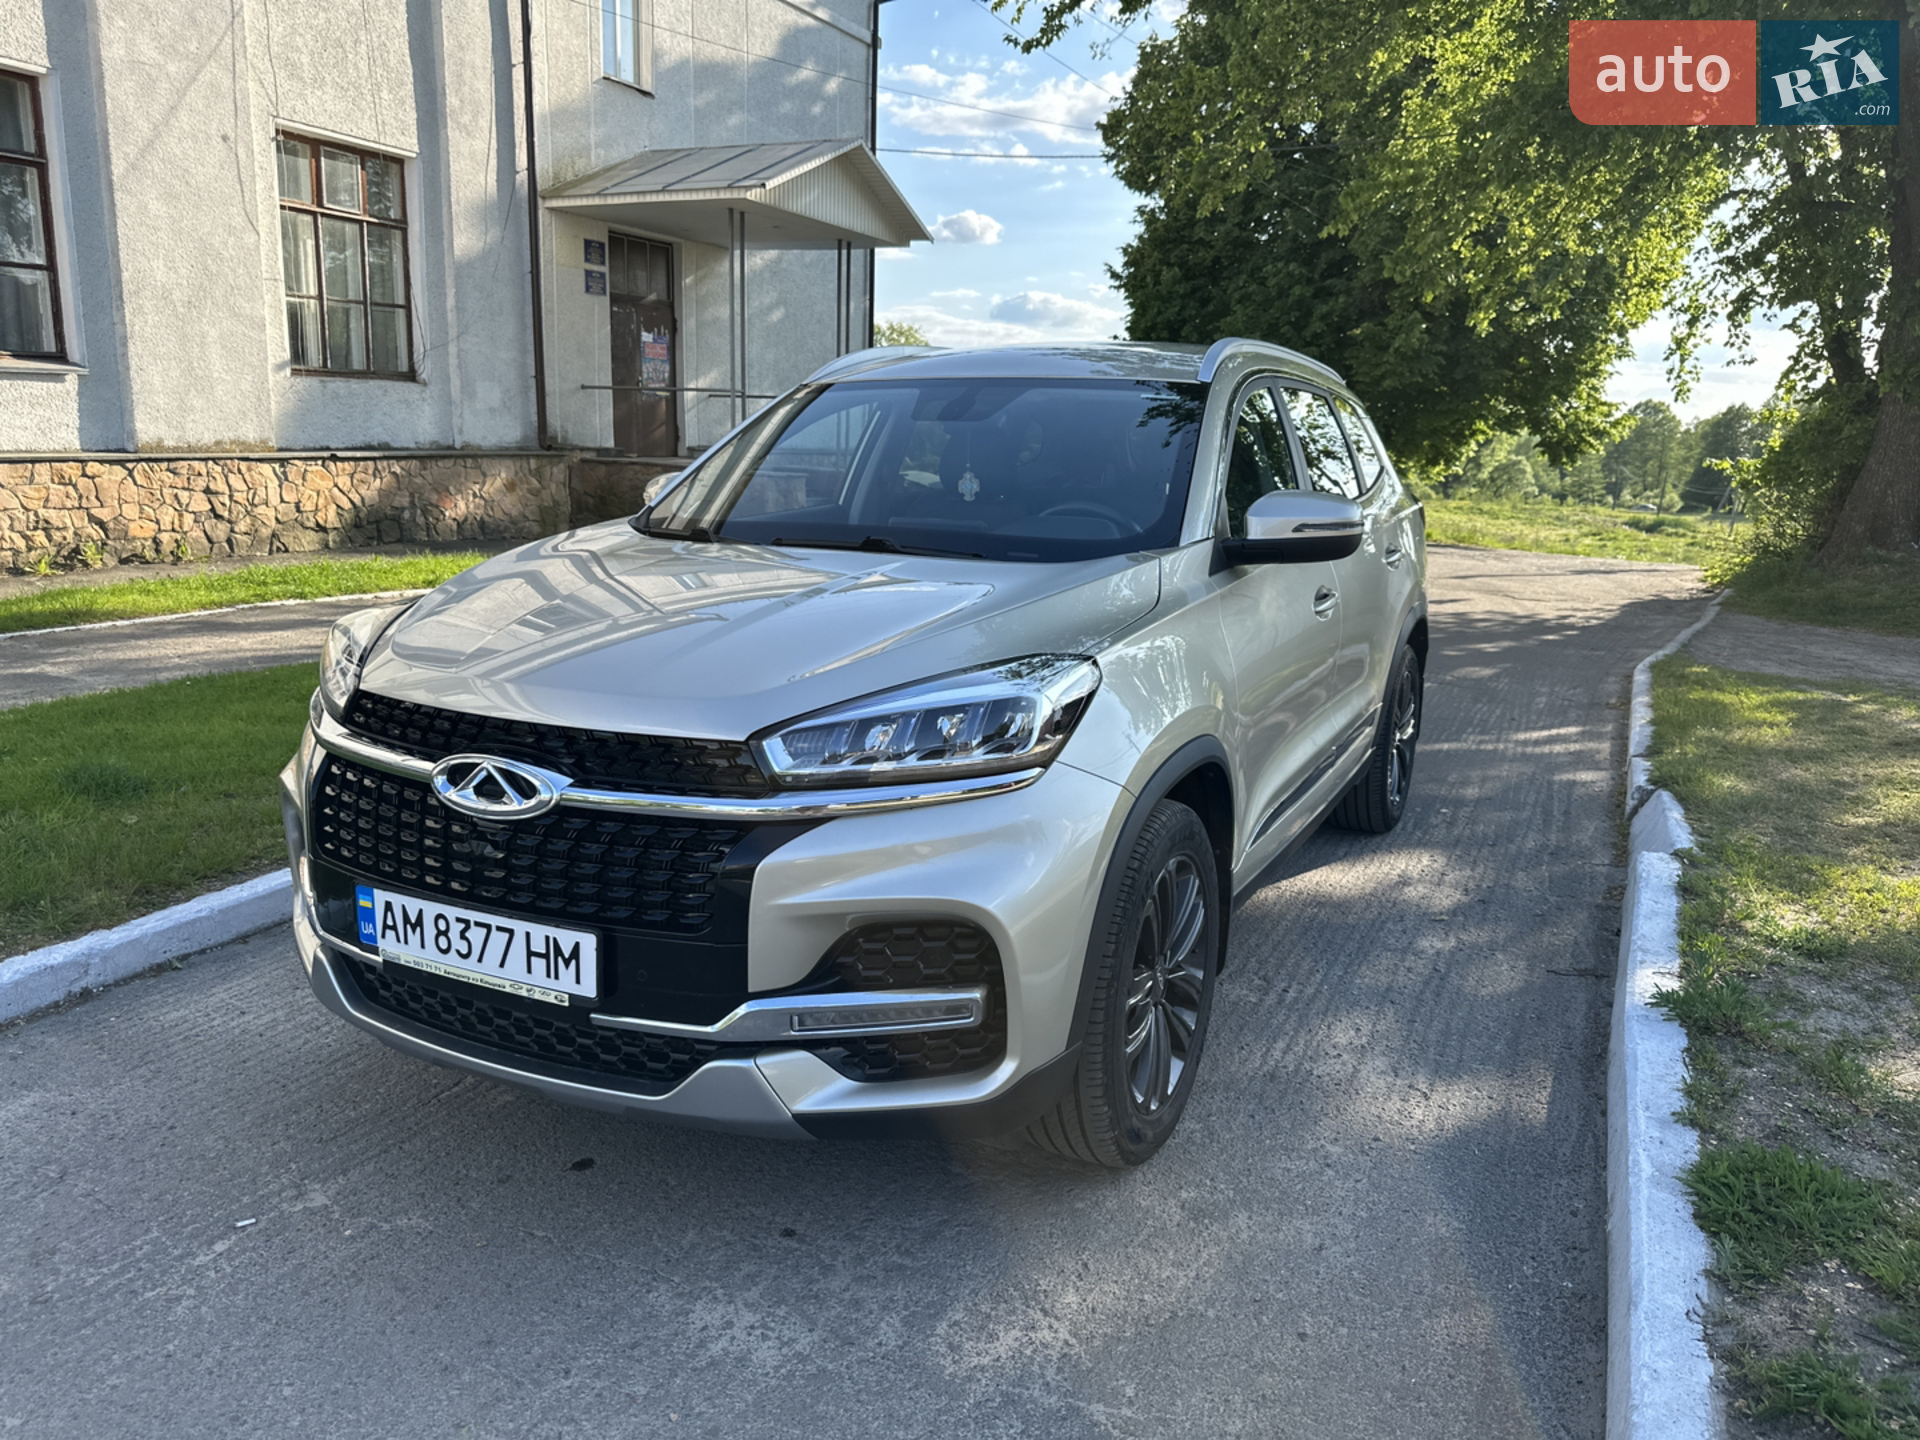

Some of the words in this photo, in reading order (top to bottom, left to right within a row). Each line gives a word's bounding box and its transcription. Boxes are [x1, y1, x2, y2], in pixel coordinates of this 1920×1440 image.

[361, 921, 375, 936] UA
[381, 901, 425, 949] AM
[434, 913, 515, 968] 8377
[525, 931, 581, 985] HM
